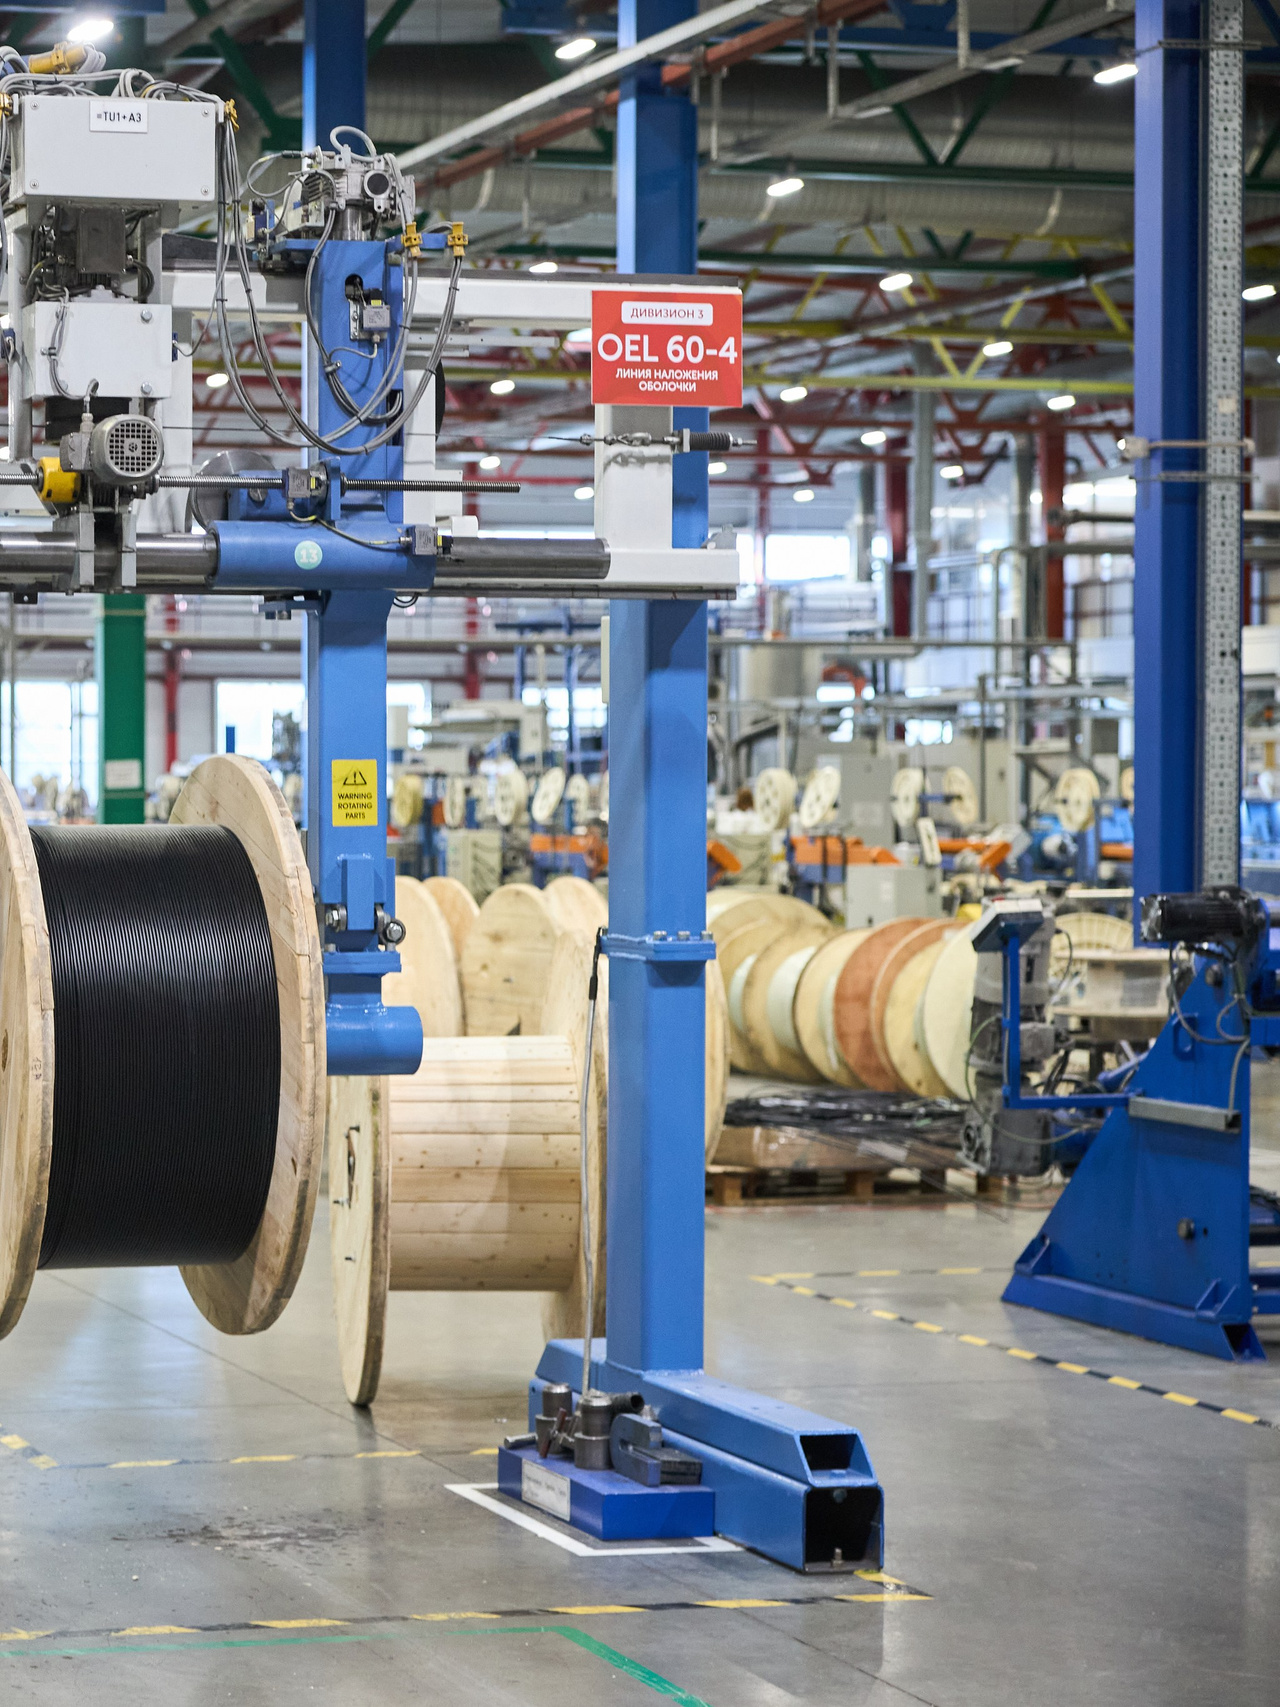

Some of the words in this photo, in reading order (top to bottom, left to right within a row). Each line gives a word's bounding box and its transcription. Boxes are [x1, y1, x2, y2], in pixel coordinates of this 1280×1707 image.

[630, 307, 695, 319] ДИВИЗИОН
[697, 309, 704, 319] 3
[597, 332, 659, 363] OEL
[666, 335, 738, 365] 60-4
[615, 367, 652, 379] ЛИНИЯ
[653, 369, 719, 381] НАЛОЖЕНИЯ
[638, 380, 697, 393] ОБОЛОЧКИ
[300, 548, 319, 564] 13
[337, 792, 373, 800] WARNING
[337, 802, 373, 810] ROTATING
